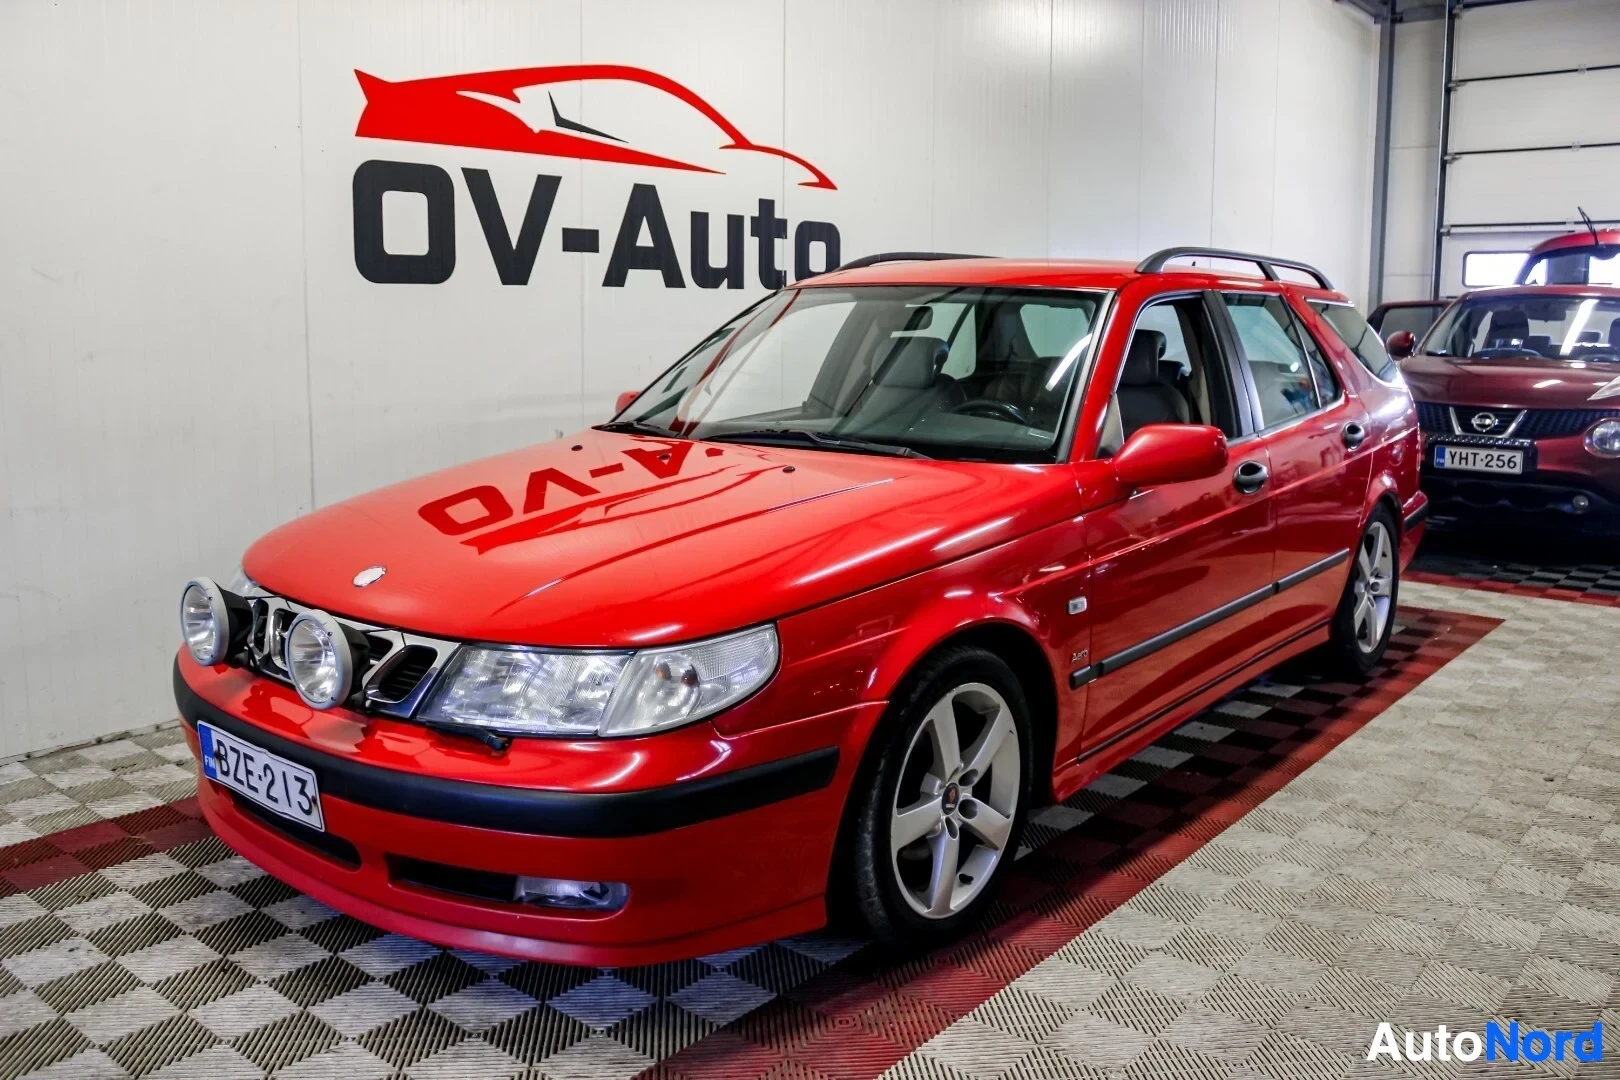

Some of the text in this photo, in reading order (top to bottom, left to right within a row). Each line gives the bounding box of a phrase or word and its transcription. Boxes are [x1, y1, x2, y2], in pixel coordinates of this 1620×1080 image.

[352, 159, 841, 290] OV-Auto
[1449, 450, 1517, 470] YHT-256
[215, 738, 313, 816] BZE-213
